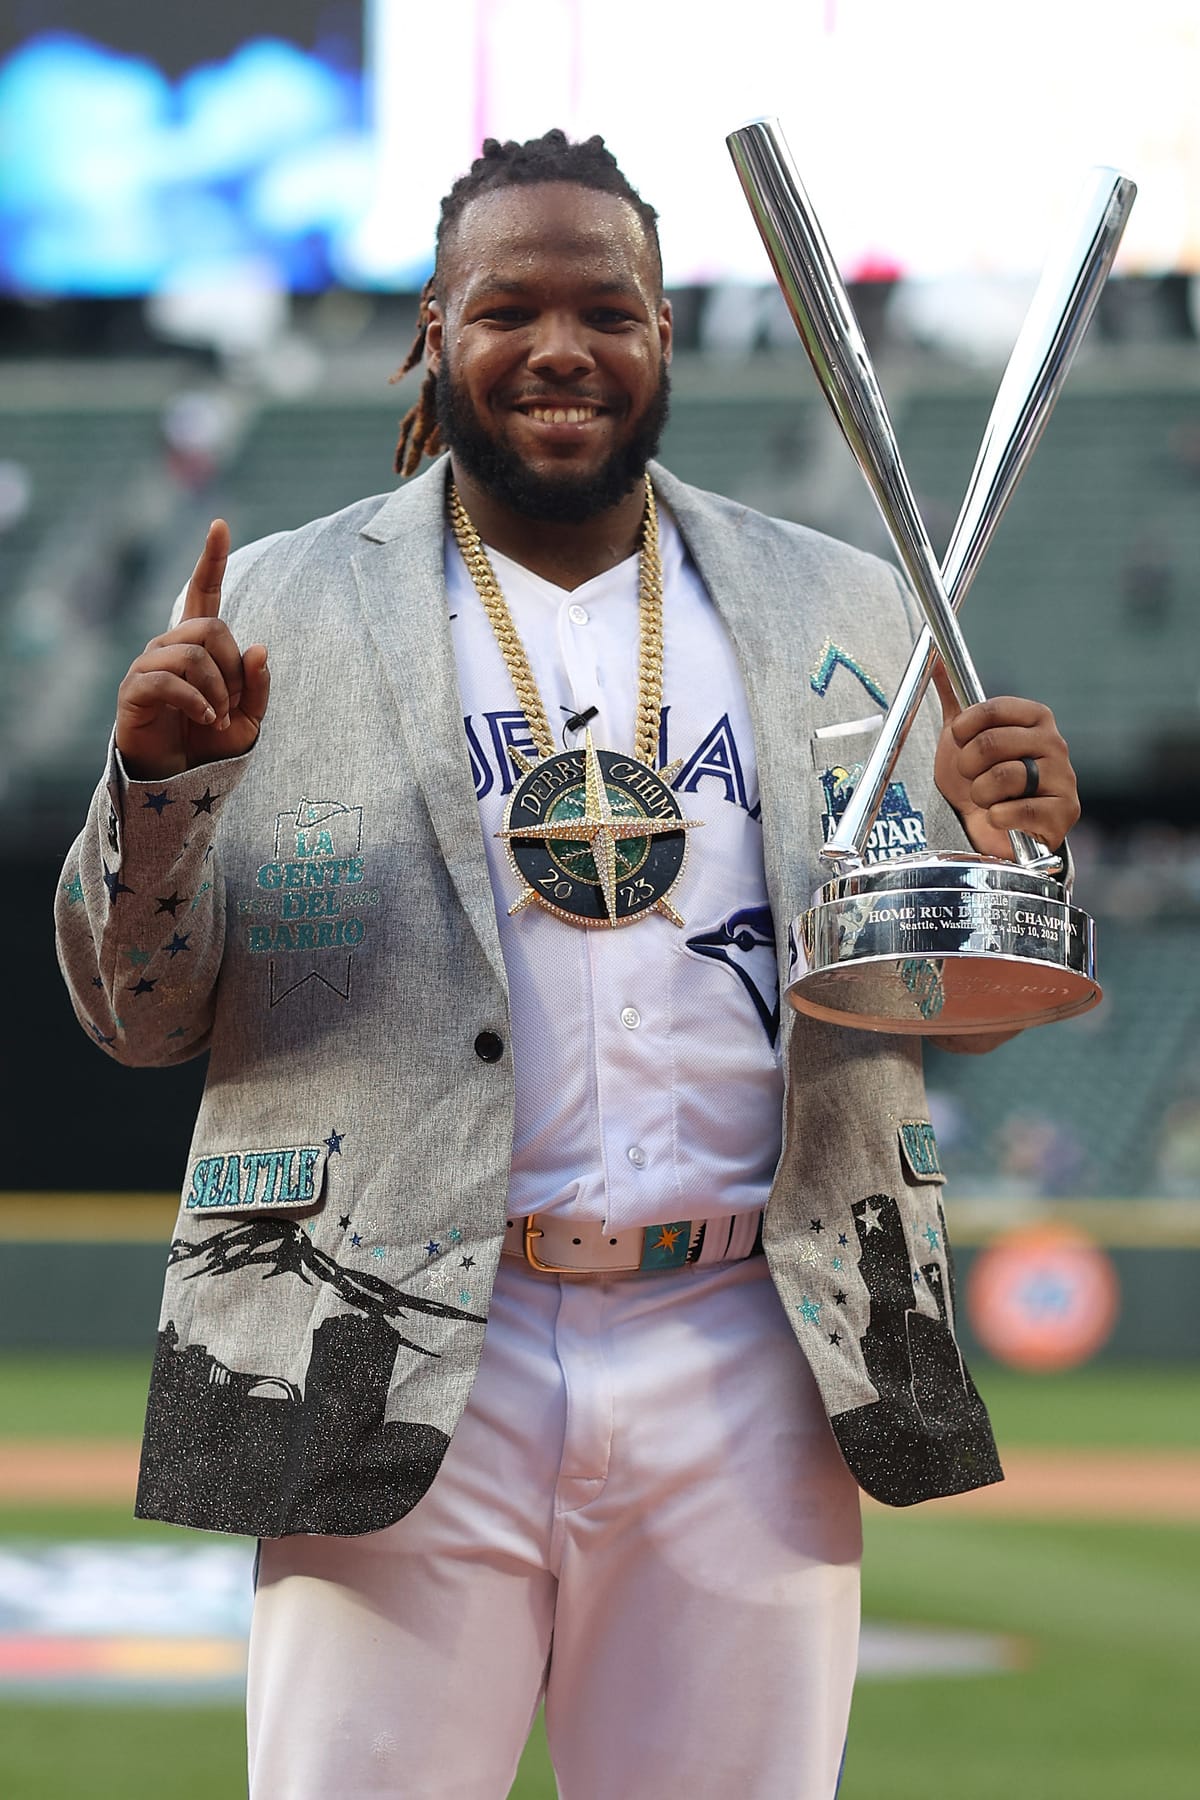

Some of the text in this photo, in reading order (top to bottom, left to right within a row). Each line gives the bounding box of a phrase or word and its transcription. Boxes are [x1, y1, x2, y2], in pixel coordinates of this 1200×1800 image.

[608, 762, 677, 820] CHAM
[296, 831, 335, 859] LA
[256, 857, 365, 890] GENTE
[538, 868, 655, 908] 20 23
[281, 890, 341, 921] DEL
[868, 907, 915, 924] HOME
[920, 906, 954, 918] RUN
[1014, 911, 1078, 936] CHAMPION
[248, 917, 365, 953] BARRIO
[900, 920, 938, 931] Seattle,
[940, 919, 998, 935] Washinn
[1006, 923, 1026, 936] July
[186, 1149, 320, 1209] SEATTLE
